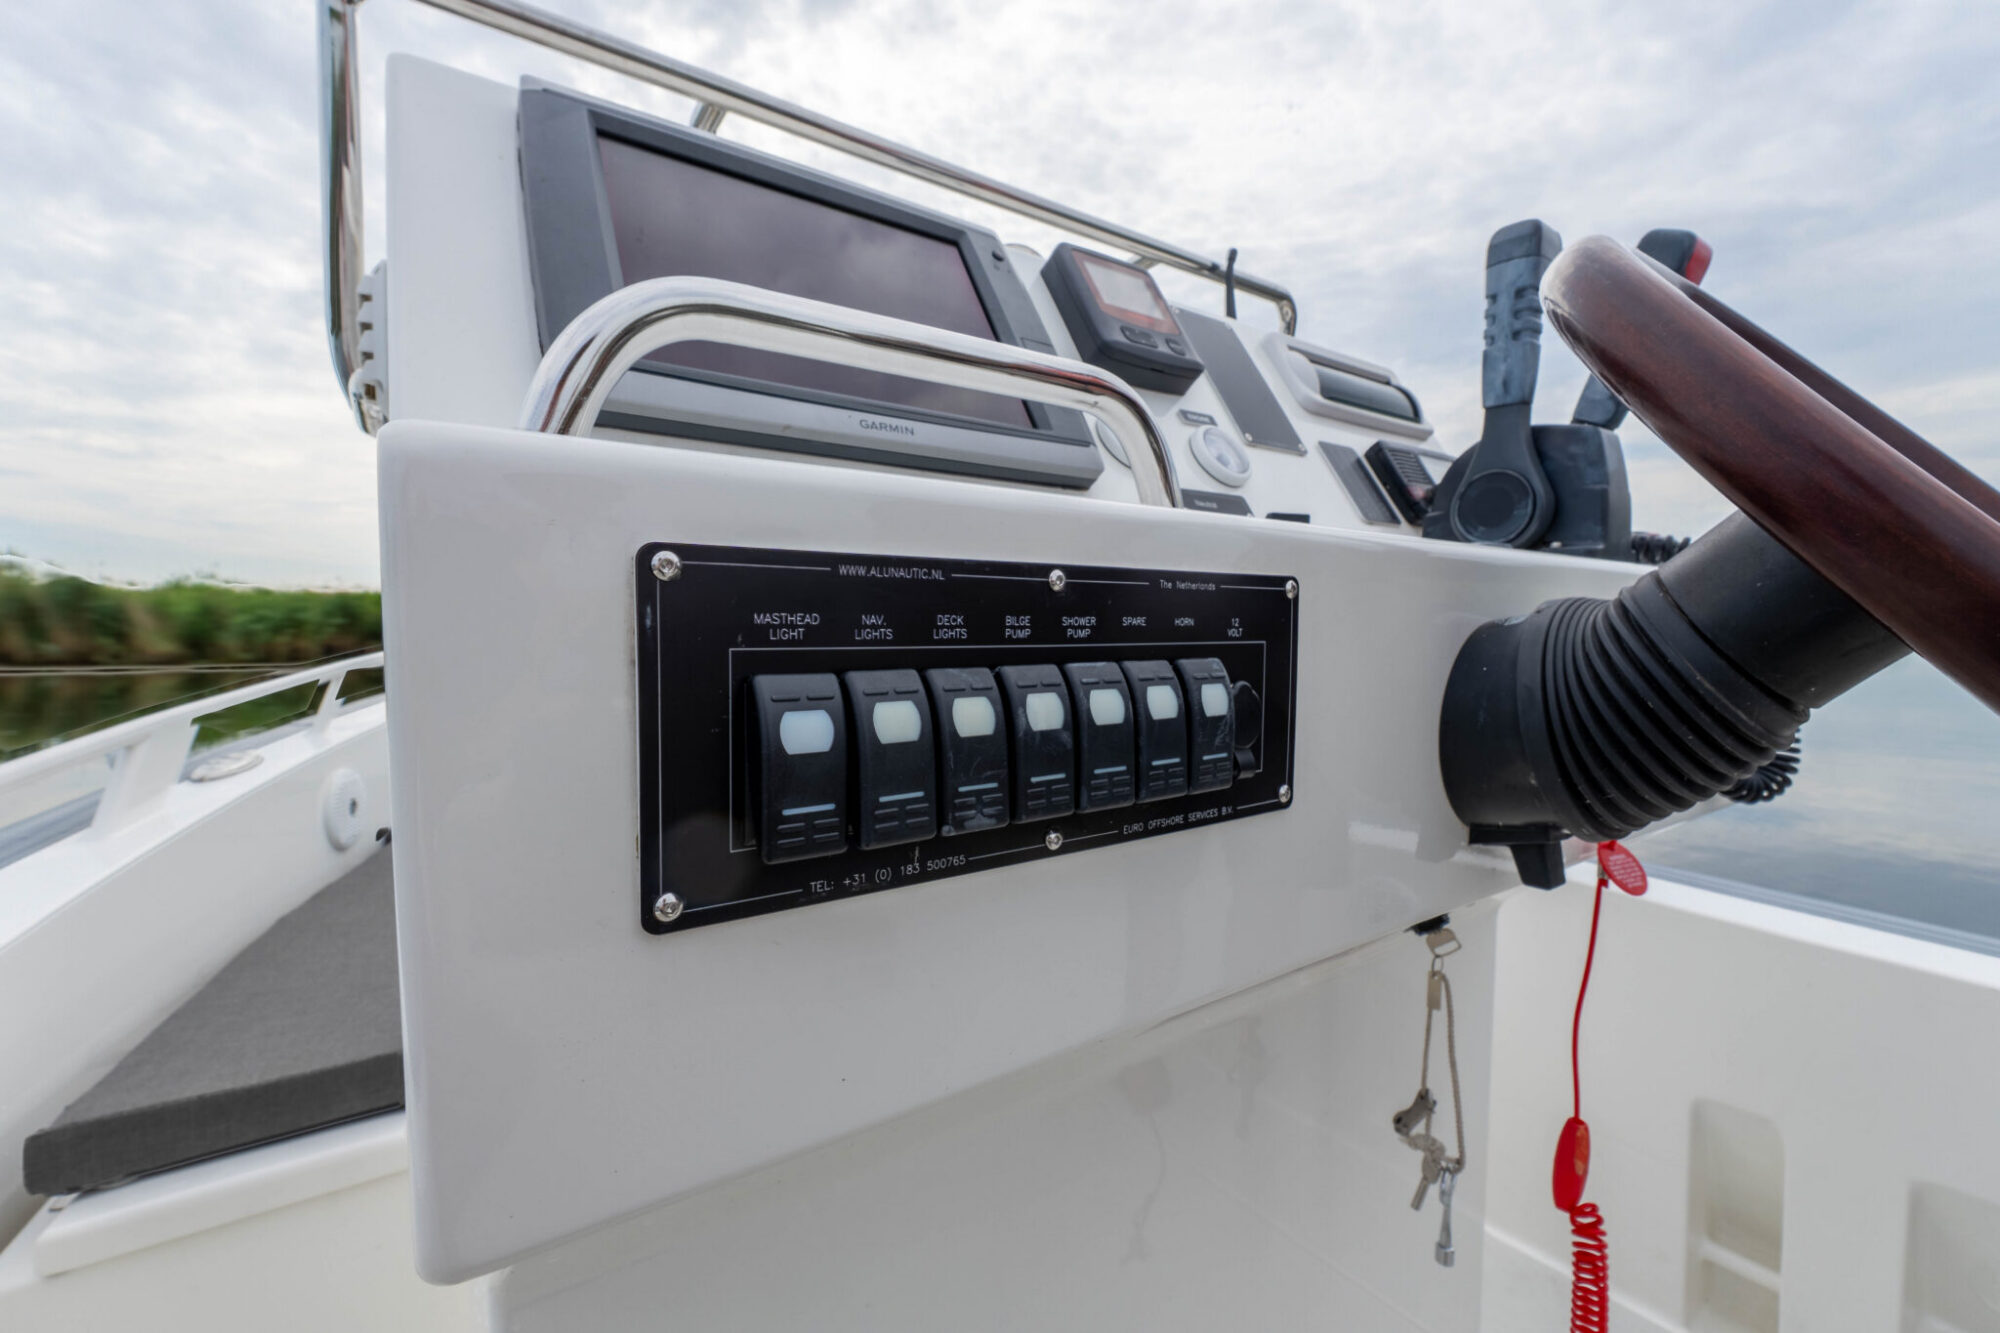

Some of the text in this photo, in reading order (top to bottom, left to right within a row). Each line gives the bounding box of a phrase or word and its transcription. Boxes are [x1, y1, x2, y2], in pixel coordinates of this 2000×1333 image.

[859, 419, 915, 436] GARMIN
[838, 564, 946, 580] WWW.ALUNAUTIC.NL
[1160, 579, 1216, 591] The Netherlands
[753, 613, 821, 625] MASTHEAD
[861, 614, 887, 626] NAV.
[936, 614, 964, 626] DECK
[1005, 615, 1031, 627] BILGE
[1062, 616, 1097, 627] SHOWER
[1122, 616, 1147, 627] SPARE
[1174, 617, 1195, 627] HORN
[1231, 617, 1240, 627] 12
[769, 628, 805, 640] LIGHT
[854, 628, 894, 640] LIGHTS
[933, 628, 968, 639] LIGHTS
[1005, 628, 1031, 639] PUMP
[1066, 628, 1092, 639] PUMP
[1227, 627, 1243, 637] VOLT
[1123, 822, 1144, 835] EURO
[1148, 814, 1184, 830] OFFSHORE
[1188, 808, 1218, 822] SERVICES
[810, 854, 966, 893] TEL: +31 (0) 183 500765
